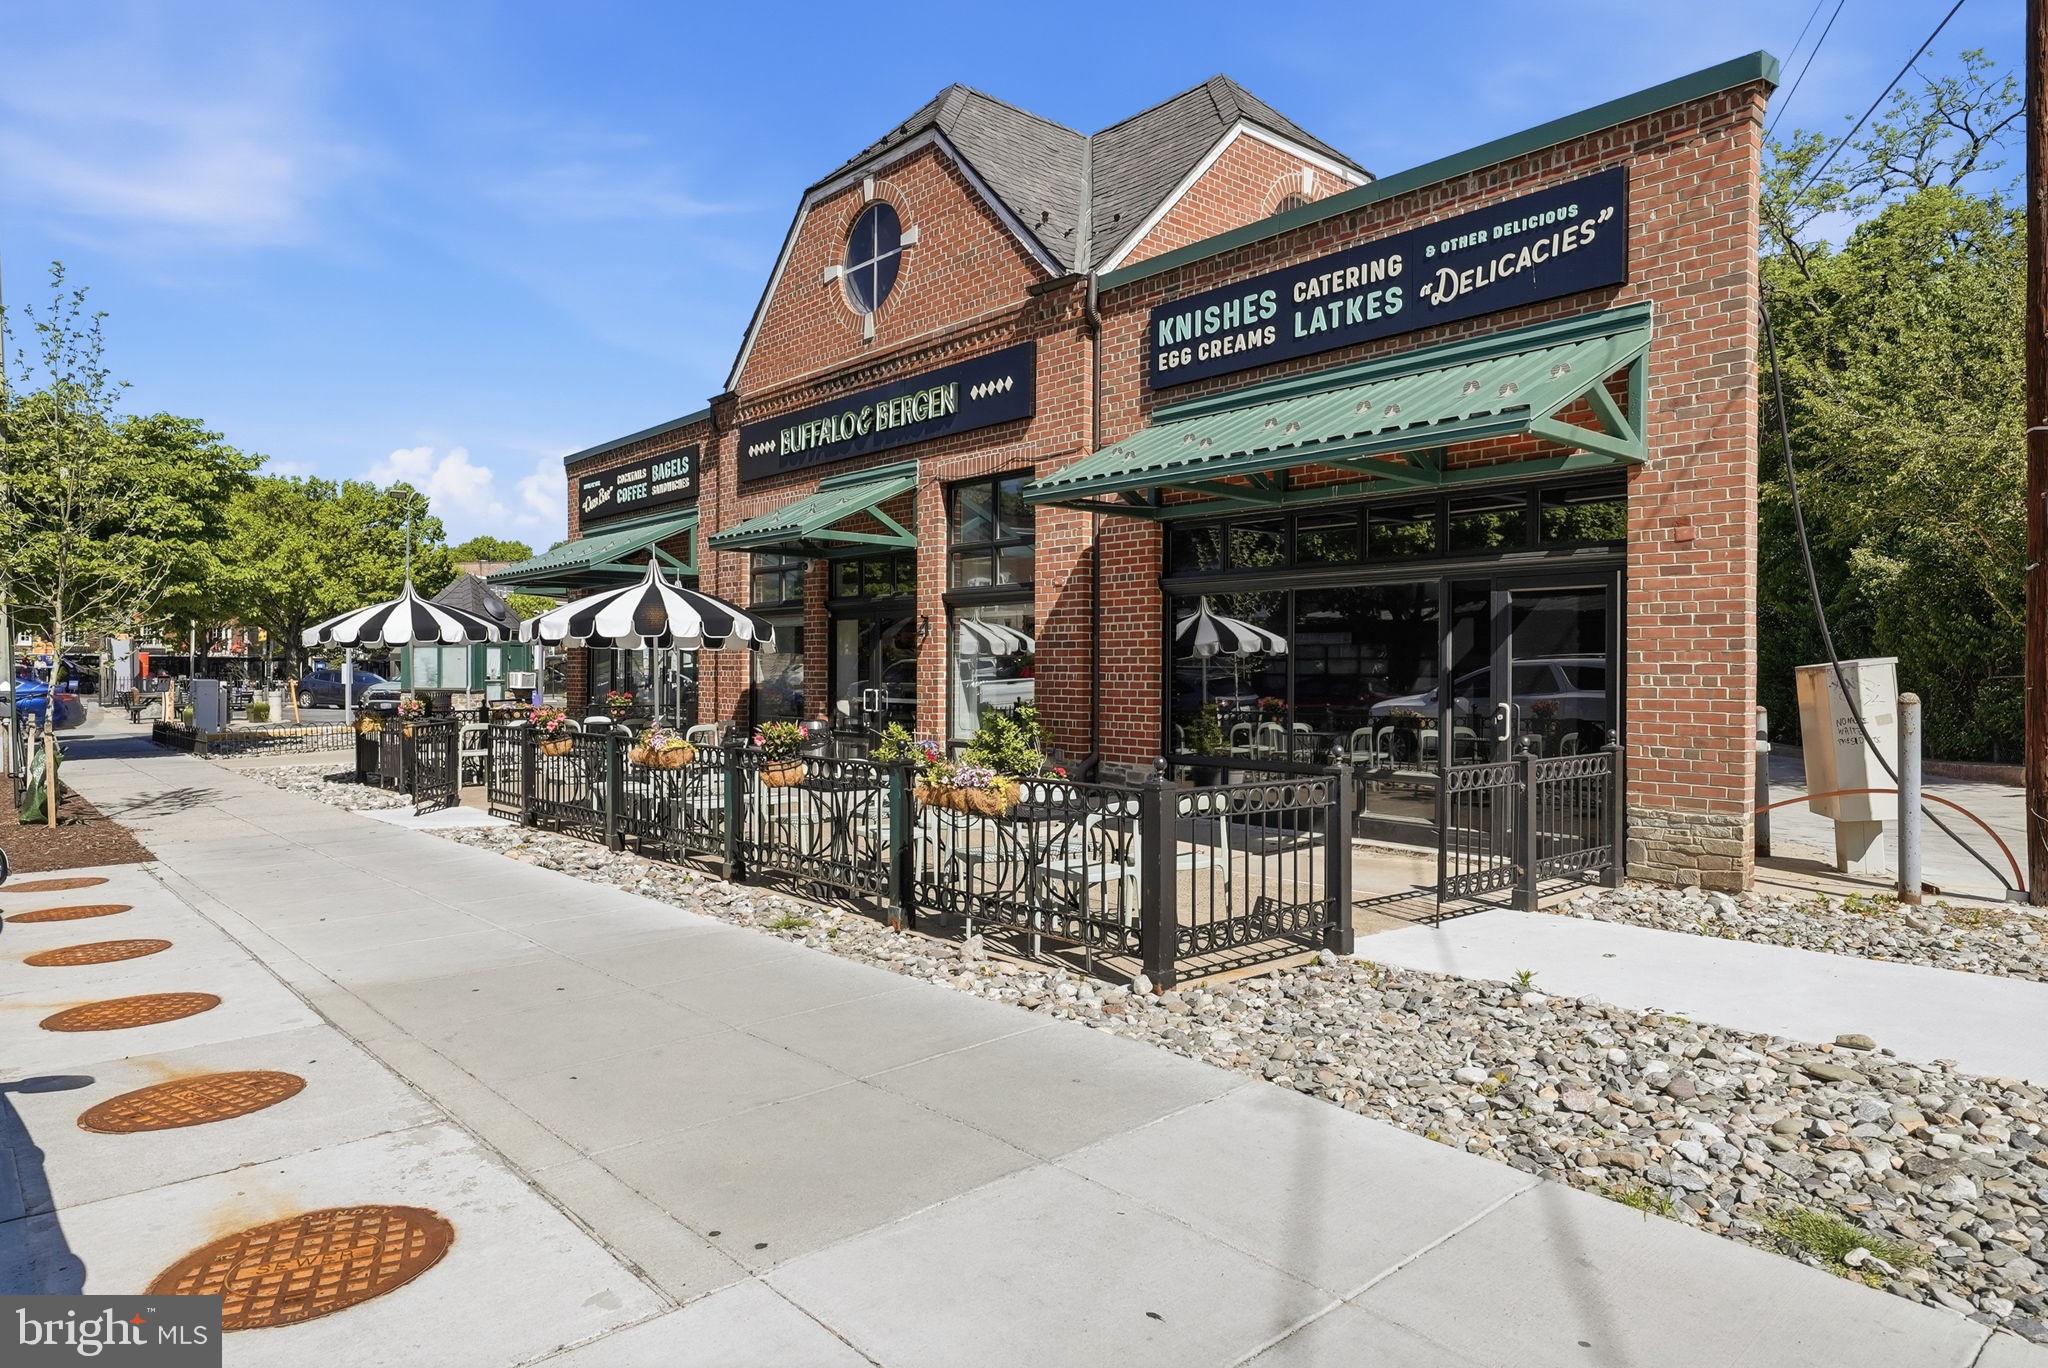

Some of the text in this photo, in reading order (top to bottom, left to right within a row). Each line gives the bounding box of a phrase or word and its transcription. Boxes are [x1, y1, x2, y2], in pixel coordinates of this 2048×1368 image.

[1440, 229, 1488, 254] OTHER
[1492, 203, 1579, 241] DELICIOUS
[1293, 254, 1403, 303] CATERING
[1158, 289, 1278, 347] KNISHES
[1294, 286, 1403, 339] LATKES
[1157, 325, 1277, 372] EGG CREAMS
[780, 405, 856, 456] BUFFALO
[875, 382, 959, 432] BERGEN
[616, 468, 647, 485] COCKTAILS
[651, 456, 690, 482] BAGELS
[651, 477, 690, 496] SANDWICHES
[616, 482, 648, 504] COFFEE
[256, 1248, 353, 1275] SEWER
